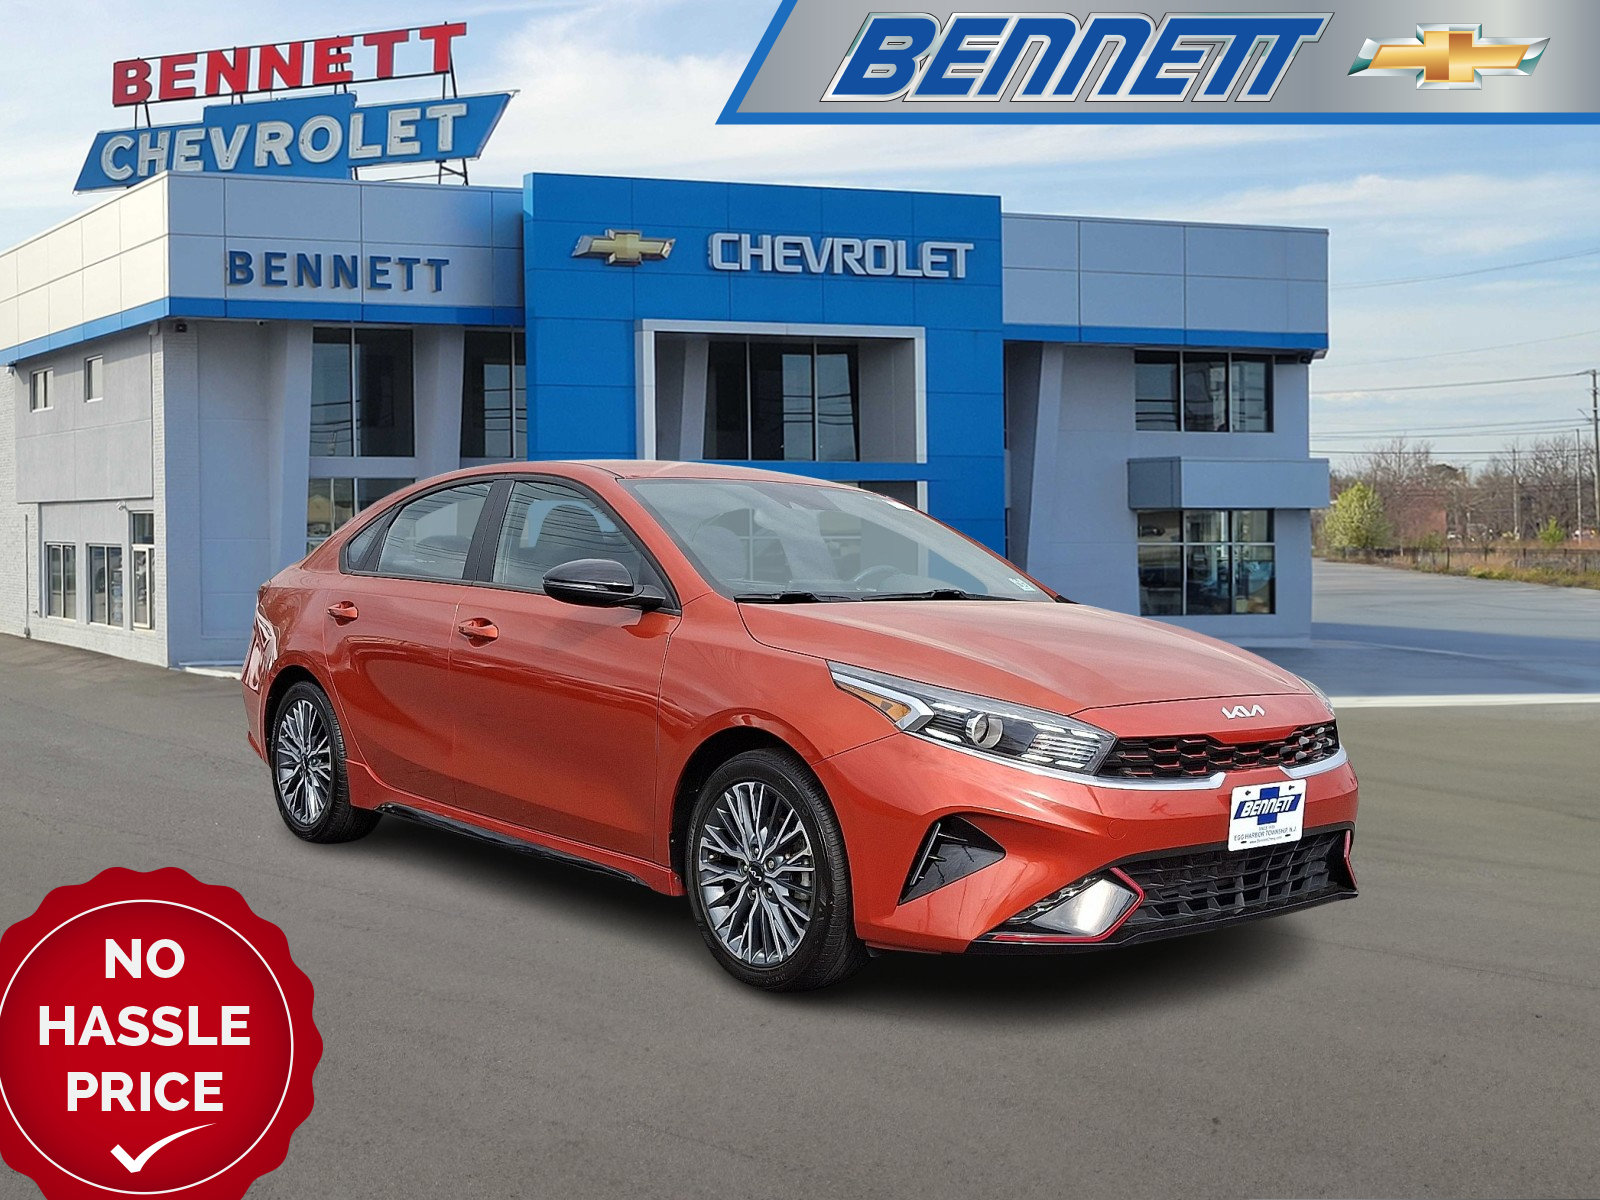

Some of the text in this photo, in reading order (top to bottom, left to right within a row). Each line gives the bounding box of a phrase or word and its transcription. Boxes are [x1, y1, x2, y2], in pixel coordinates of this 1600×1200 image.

[112, 22, 467, 107] BENNETT
[101, 104, 467, 181] CHEVROLET
[227, 250, 449, 292] BENNETT
[708, 232, 974, 278] CHEVROLET
[1240, 796, 1295, 817] BENNETT
